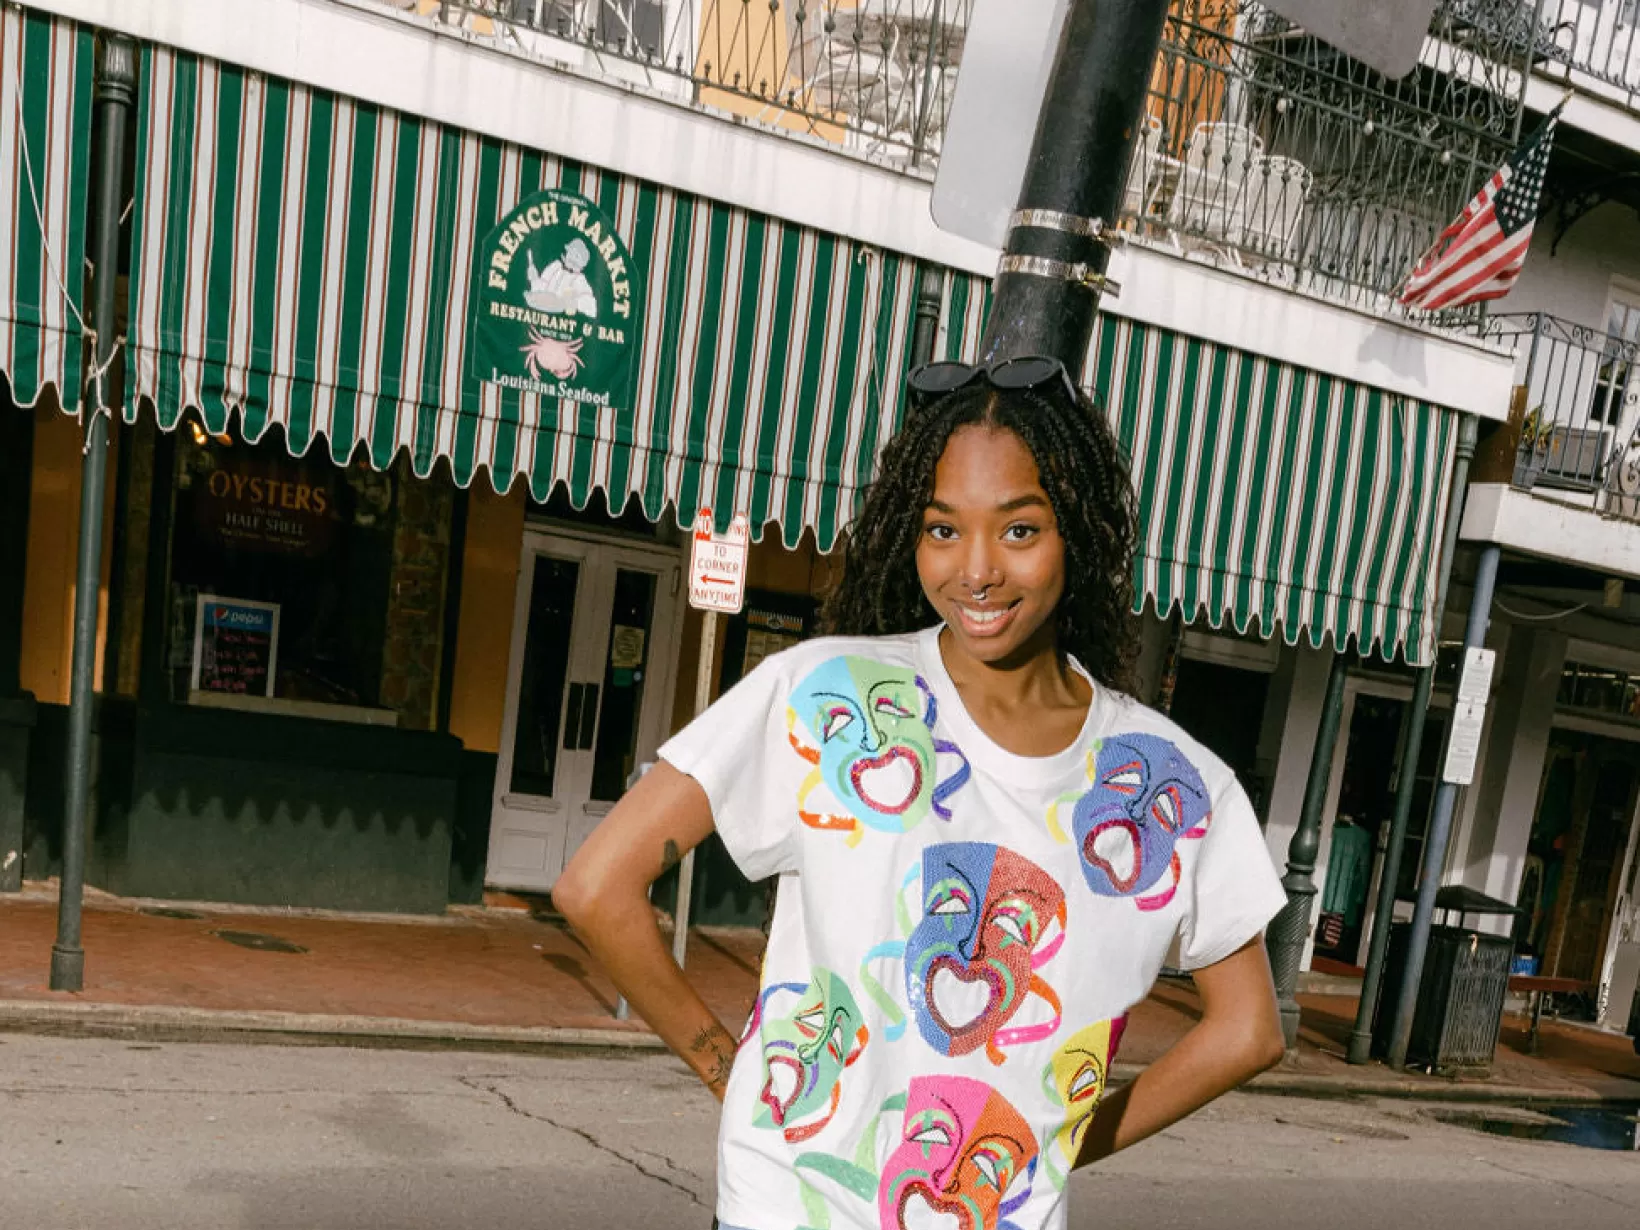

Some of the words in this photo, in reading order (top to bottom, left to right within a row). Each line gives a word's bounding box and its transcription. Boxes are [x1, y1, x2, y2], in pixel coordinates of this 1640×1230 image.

[488, 201, 559, 291] FRENCH
[568, 205, 630, 319] MARKET
[490, 301, 577, 333] RESTAURANT
[583, 323, 592, 336] &
[598, 326, 625, 344] BAR
[491, 367, 556, 397] Louisiana
[558, 380, 610, 405] Seafood
[208, 470, 327, 513] OYSTERS
[225, 511, 261, 530] HALF
[714, 545, 727, 557] TO
[697, 559, 739, 574] CORNER
[694, 588, 738, 604] ANYTIME
[230, 609, 264, 625] pepsi
